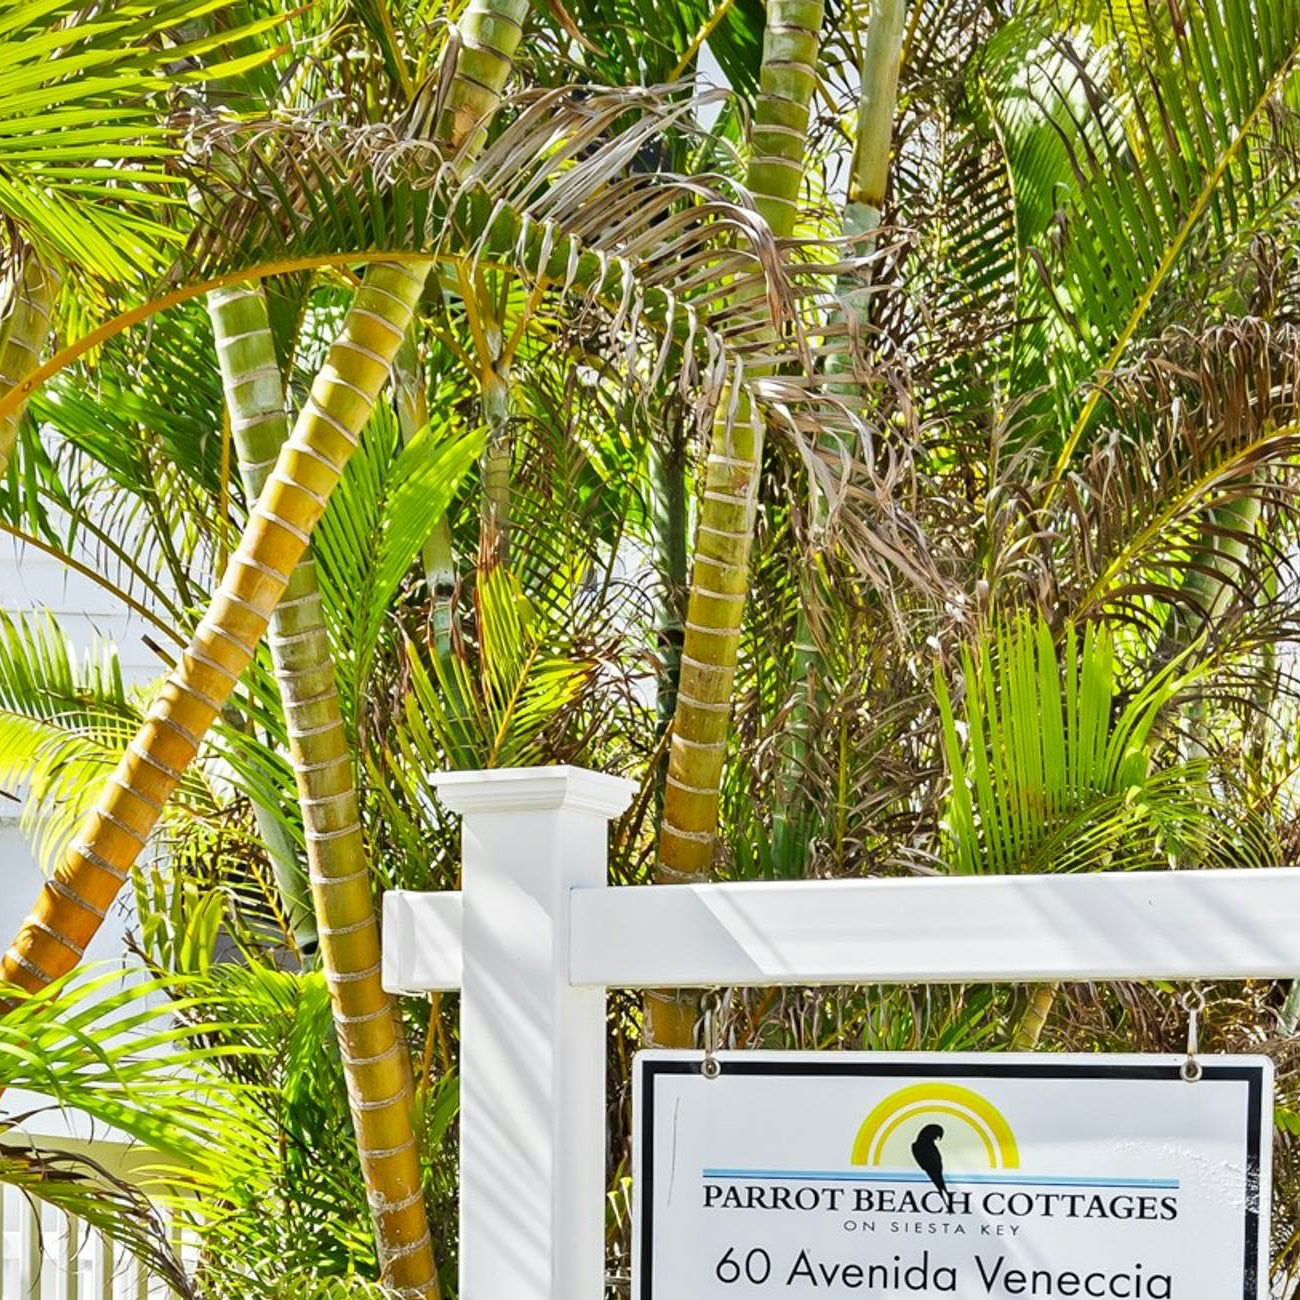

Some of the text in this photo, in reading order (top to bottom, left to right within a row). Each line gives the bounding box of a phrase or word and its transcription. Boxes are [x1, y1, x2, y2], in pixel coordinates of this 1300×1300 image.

[703, 1184, 1178, 1221] PARROT BEACH COTTAGES
[843, 1220, 1020, 1236] ON SIESTA KEY
[715, 1247, 1172, 1300] 60 Avenida Veneccia
